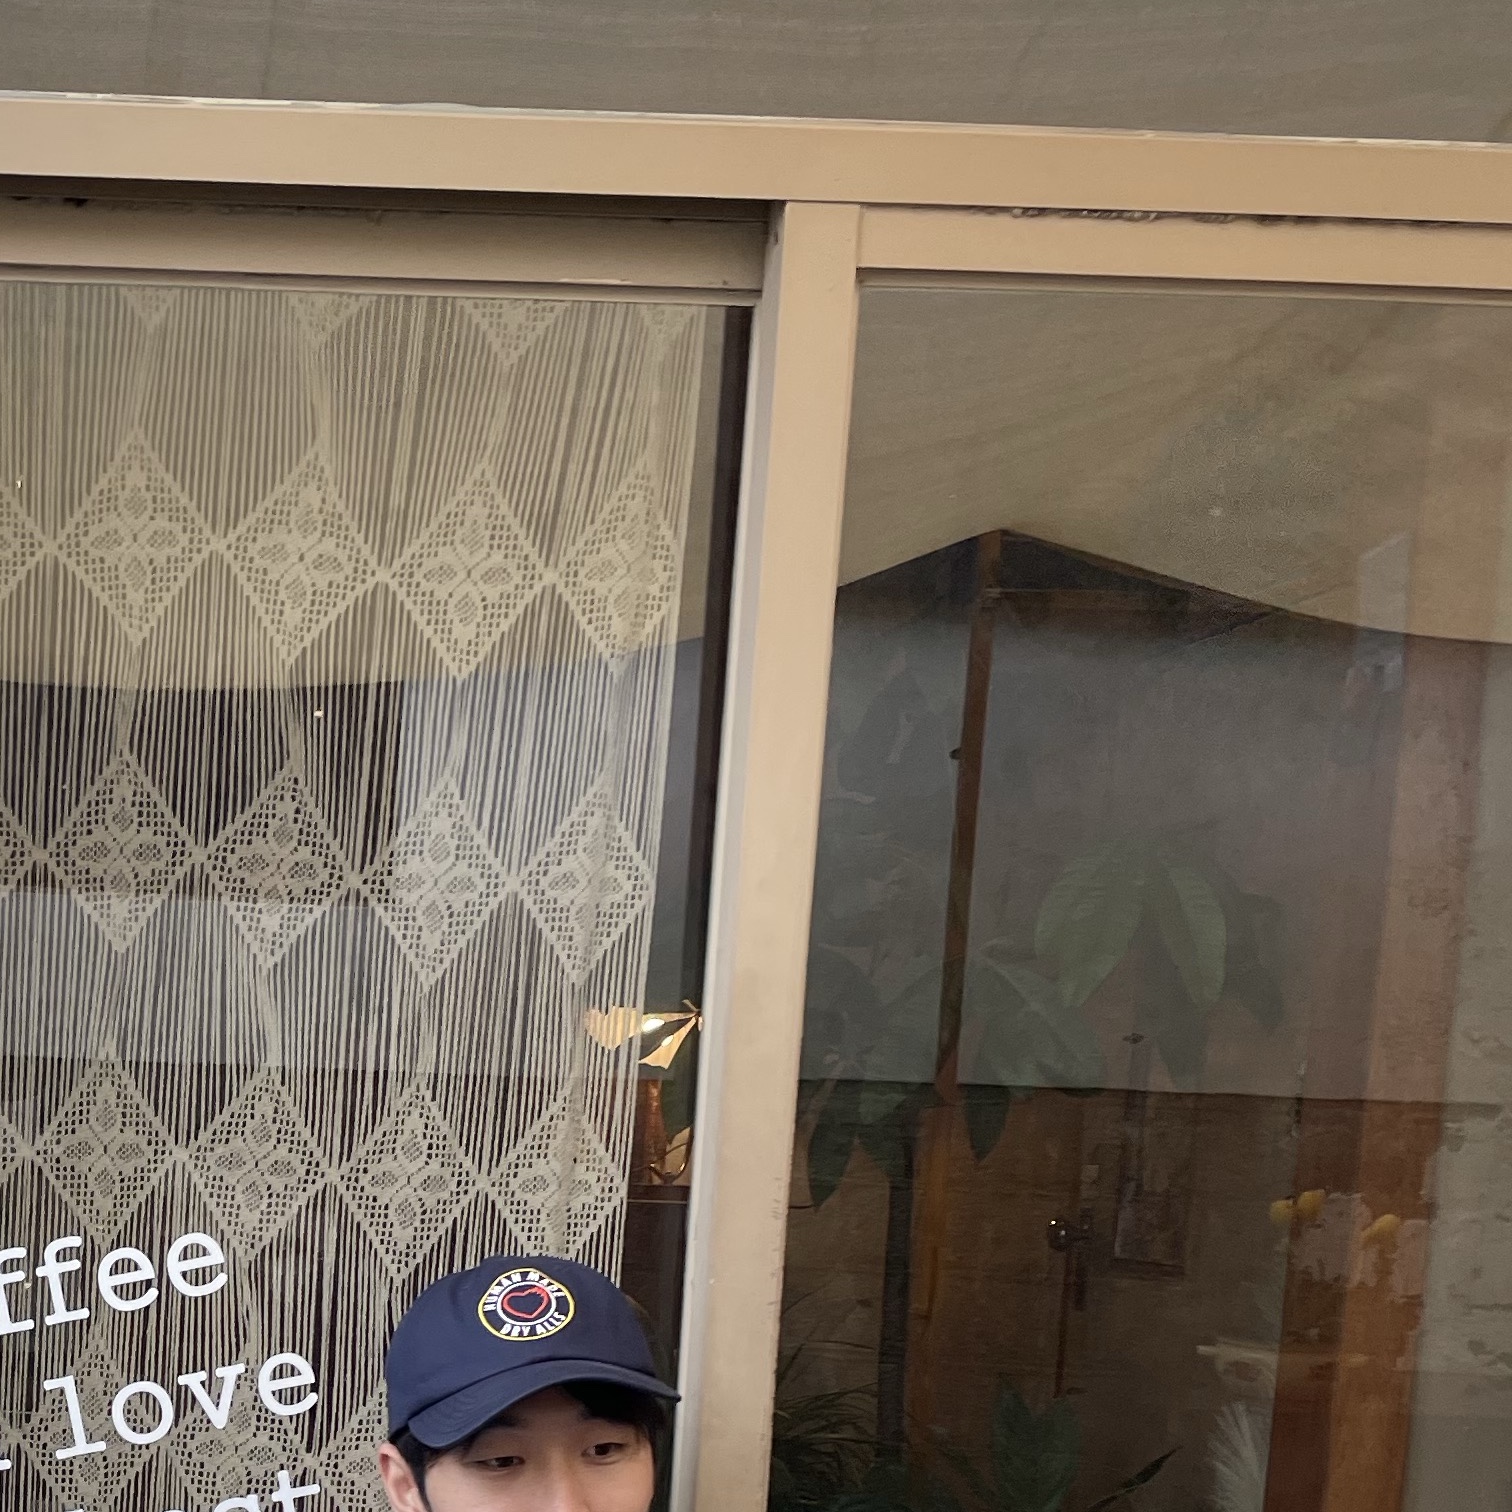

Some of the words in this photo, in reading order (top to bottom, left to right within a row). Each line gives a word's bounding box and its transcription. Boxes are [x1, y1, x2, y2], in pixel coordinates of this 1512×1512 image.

[483, 1272, 521, 1312] HUMAN
[499, 1323, 531, 1337] DRY
[535, 1311, 567, 1335] ALLS
[43, 1352, 319, 1460] love
